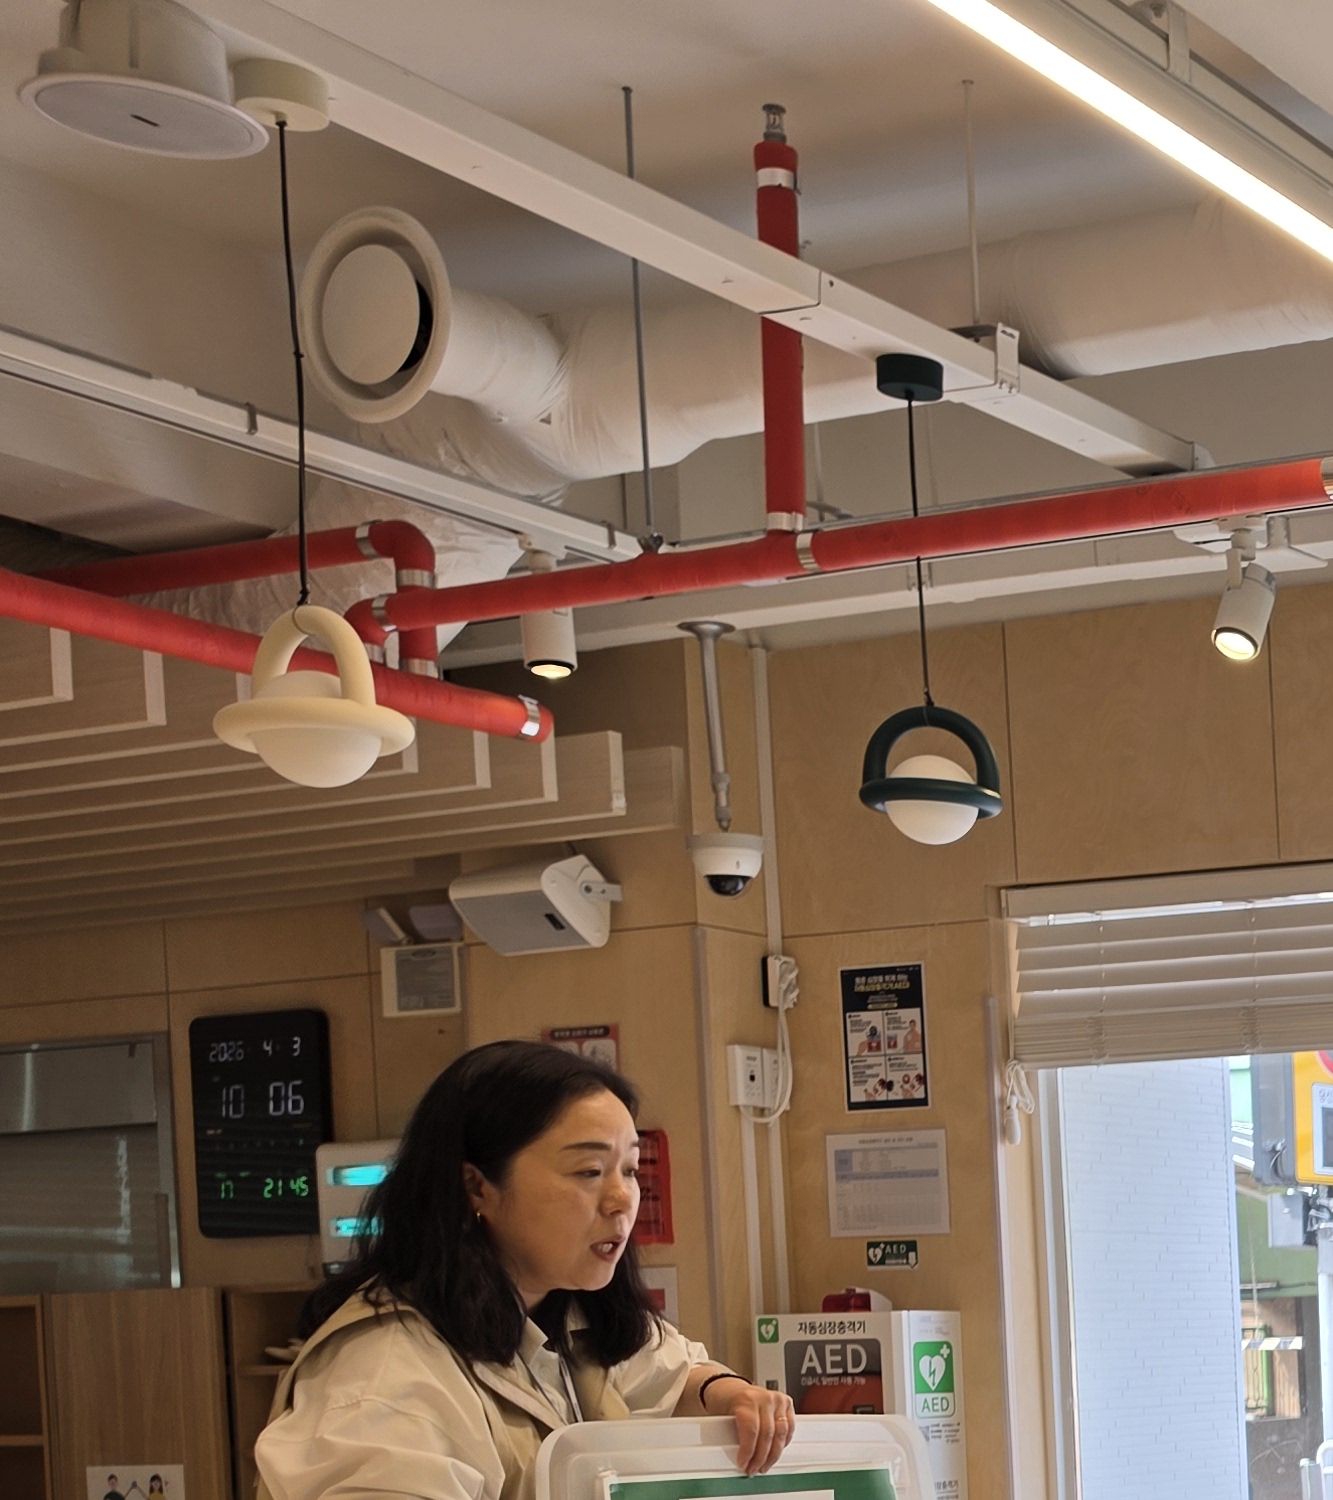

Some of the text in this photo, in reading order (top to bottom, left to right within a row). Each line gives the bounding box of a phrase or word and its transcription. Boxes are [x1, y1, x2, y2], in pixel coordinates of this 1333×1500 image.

[263, 1040, 273, 1057] 4
[292, 1036, 301, 1057] 3
[222, 1080, 304, 1119] 10 06
[884, 1244, 906, 1254] AED
[798, 1320, 866, 1335] 자동심장충격기
[801, 1344, 868, 1375] AED
[922, 1397, 950, 1413] AED
